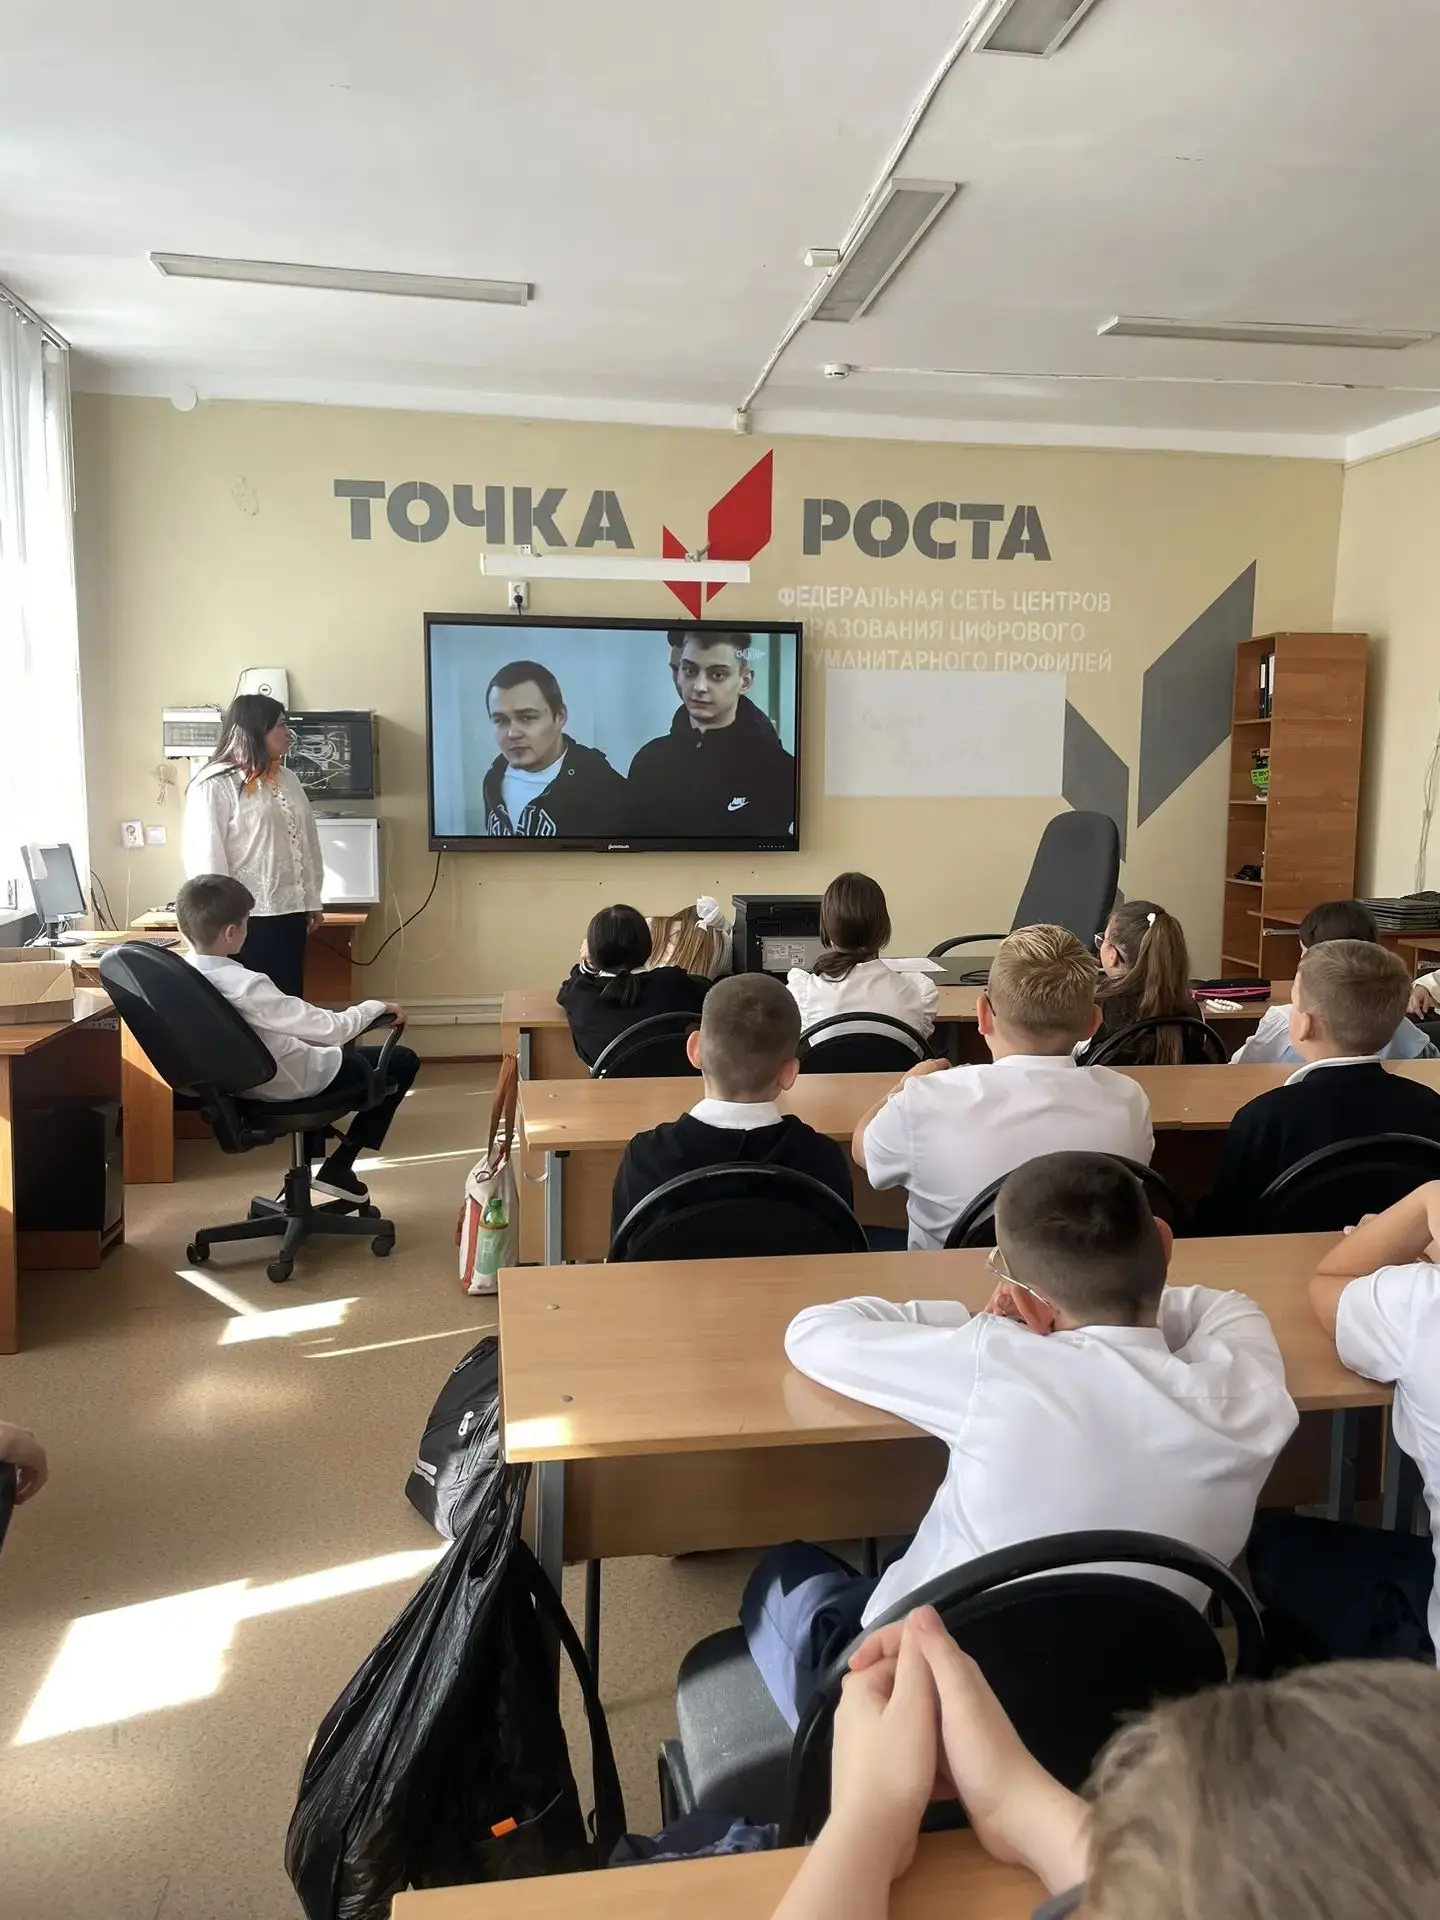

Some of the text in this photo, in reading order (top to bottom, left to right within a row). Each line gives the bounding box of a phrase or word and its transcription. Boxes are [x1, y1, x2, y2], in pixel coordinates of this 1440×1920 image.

[333, 478, 1053, 562] ТОЧКА РОСТА
[778, 585, 1112, 614] ФЕДЕРАЛЬНАЯ СЕТЬ ЦЕНТРОВ
[779, 617, 1086, 644] РАЗОВАНИЯ ЦИФРОВОГО
[811, 648, 1113, 674] УМАНИТАРНОГО ПРОФИЛЕЙ
